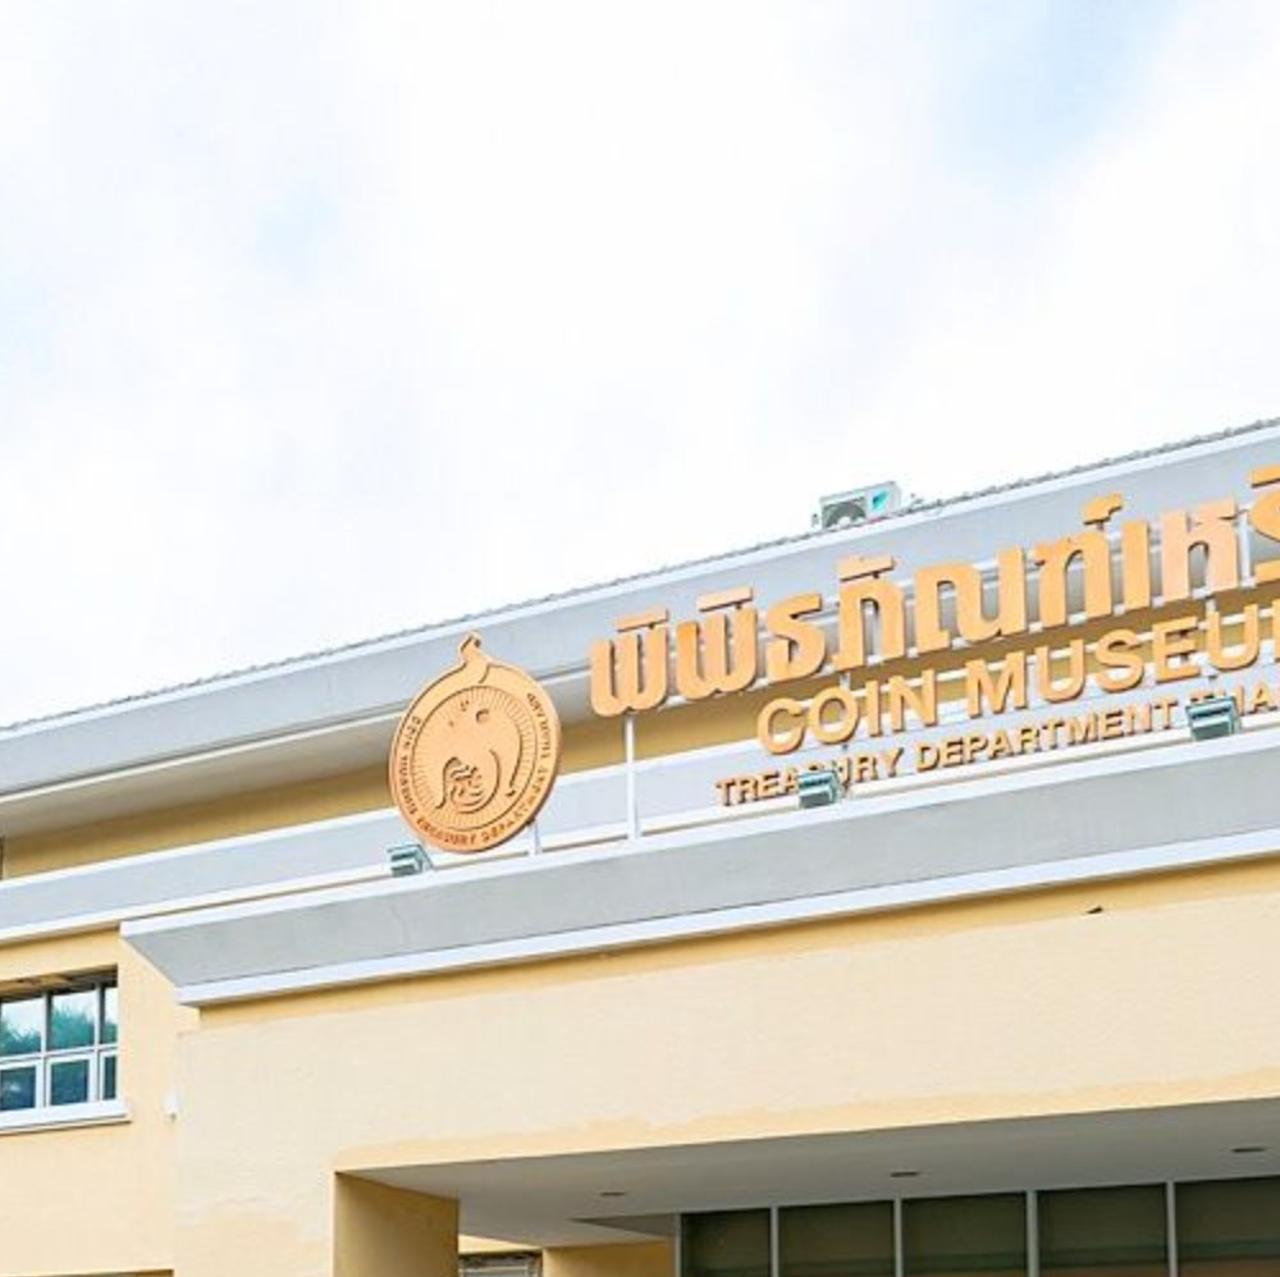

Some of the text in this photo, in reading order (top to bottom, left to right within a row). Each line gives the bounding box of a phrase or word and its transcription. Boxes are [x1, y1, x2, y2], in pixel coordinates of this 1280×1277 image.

[716, 748, 905, 806] TREAURY
[918, 698, 1179, 773] DEPARTMENT
[757, 669, 938, 755] COIN
